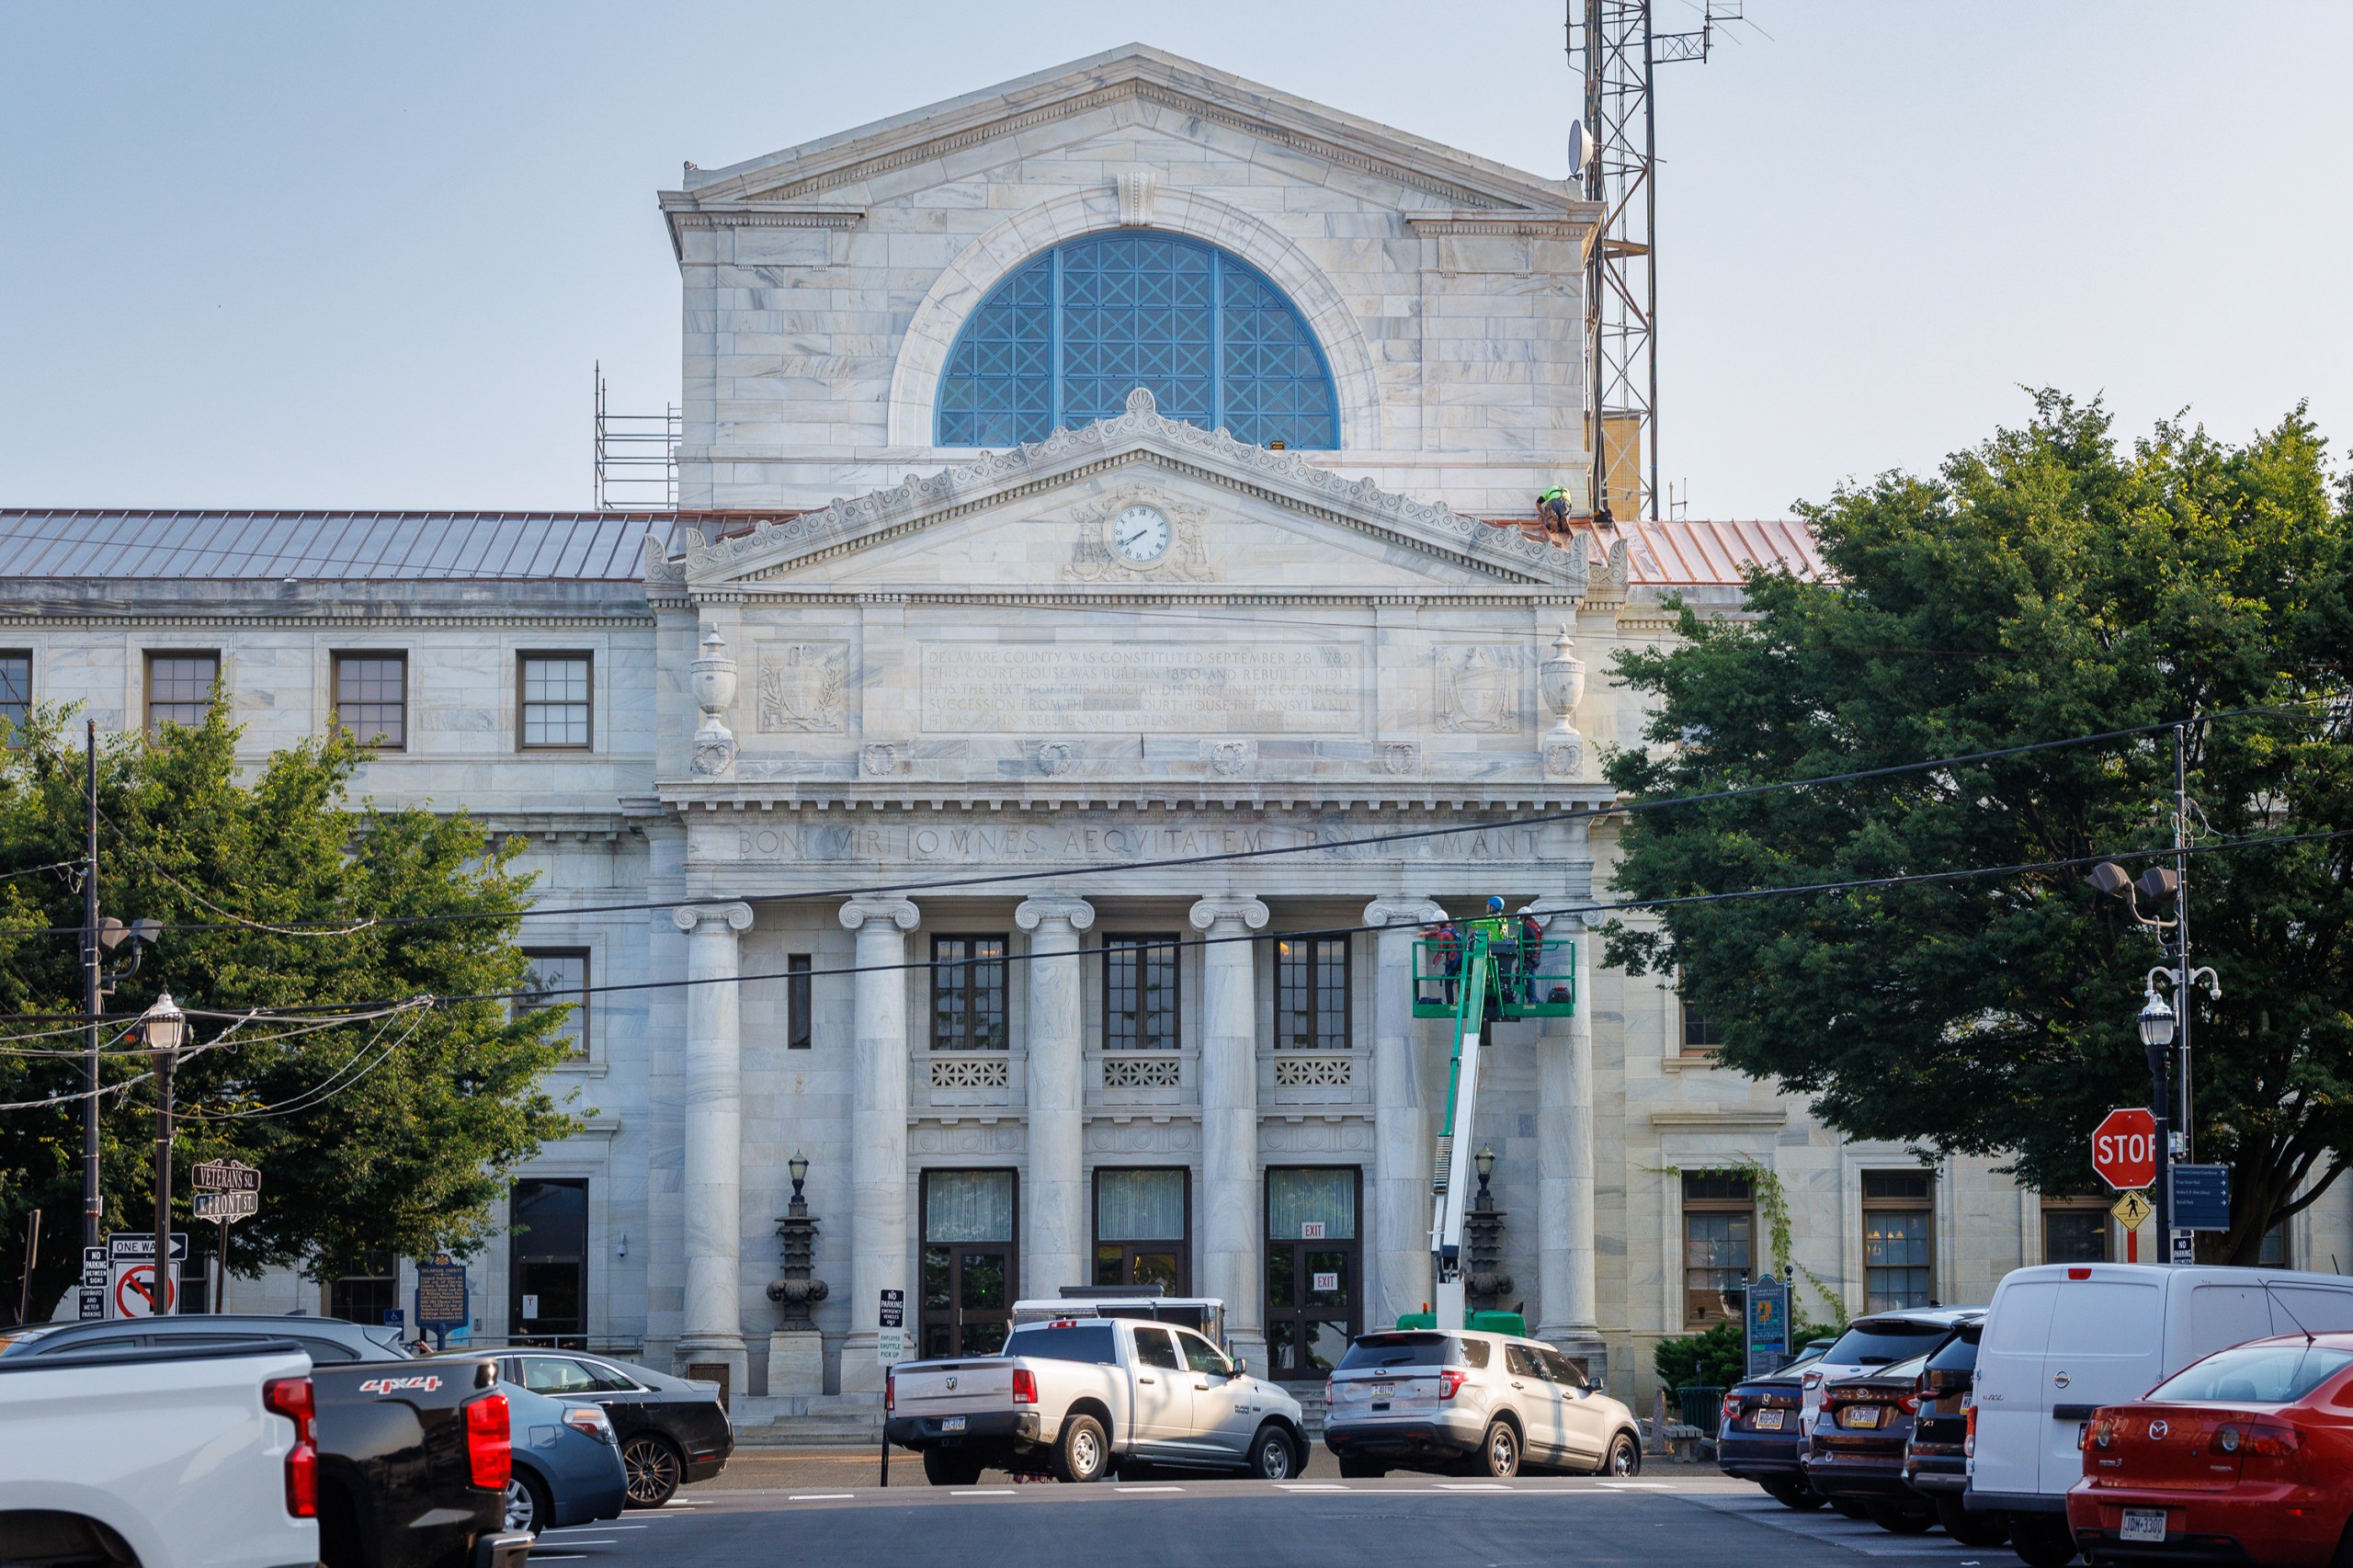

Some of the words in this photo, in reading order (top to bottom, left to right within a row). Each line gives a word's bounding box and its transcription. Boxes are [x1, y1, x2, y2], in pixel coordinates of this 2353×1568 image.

[929, 652, 996, 664] DELAWARE
[1004, 652, 1062, 664] COUNTY
[1070, 652, 1096, 664] WAS
[1100, 652, 1202, 664] CONSTITUTED
[1208, 652, 1285, 664] SEPTEMBER
[1295, 652, 1312, 664] 26
[1319, 652, 1352, 664] 1789
[930, 667, 960, 680] THIS
[965, 667, 1015, 680] COURT
[1021, 667, 1066, 680] HOUSE
[1072, 667, 1097, 680] WAS
[1103, 667, 1138, 680] BUILT
[1145, 667, 1160, 680] IN
[1166, 667, 1200, 680] 1850
[1208, 667, 1236, 680] AND
[1244, 667, 1297, 680] REBUILT
[1305, 667, 1318, 680] IN
[1324, 667, 1352, 680] 1913
[930, 684, 939, 696] IT
[943, 684, 956, 696] IS
[962, 684, 985, 696] THE
[991, 684, 1031, 696] SIXTH
[1038, 684, 1055, 696] OF
[1061, 684, 1089, 696] THIS
[1096, 684, 1155, 696] JUDICIAL
[1162, 684, 1223, 696] DISTRICT
[1229, 684, 1242, 696] IN
[1246, 684, 1275, 696] LINE
[1279, 684, 1296, 696] OF
[1302, 684, 1352, 696] DIRECT
[929, 699, 1016, 711] SUCCESSION
[1022, 699, 1061, 711] FROM
[1064, 699, 1086, 711] THE
[1092, 699, 1127, 711] FIRST
[1131, 699, 1182, 711] COURT
[1186, 699, 1230, 711] HOUSE
[1235, 699, 1248, 711] IN
[1252, 699, 1352, 711] PENNSYLVANIA
[930, 715, 939, 726] IT
[947, 715, 971, 726] WAS
[978, 715, 1017, 726] AGAIN
[1028, 715, 1077, 726] REBUILT
[1088, 715, 1115, 726] AND
[1125, 715, 1210, 726] EXTENSIVELY
[1220, 715, 1294, 726] ENLARGED
[1302, 715, 1313, 726] IN
[739, 830, 809, 854] BONI
[833, 830, 892, 854] VIRI
[915, 830, 1040, 853] OMNES
[1064, 829, 1262, 854] AEQVITATEM
[1293, 829, 1390, 854] IPSAM
[1417, 829, 1539, 854] AMANT
[200, 1167, 243, 1188] VETERANS
[244, 1173, 254, 1187] SQ.
[199, 1199, 206, 1213] W.
[208, 1195, 241, 1214] FRONT
[244, 1196, 254, 1210] ST.
[1305, 1224, 1322, 1237] EXIT
[116, 1243, 139, 1252] ONE
[142, 1243, 155, 1252] WA
[2178, 1241, 2186, 1249] NO
[1318, 1276, 1335, 1288] EXIT
